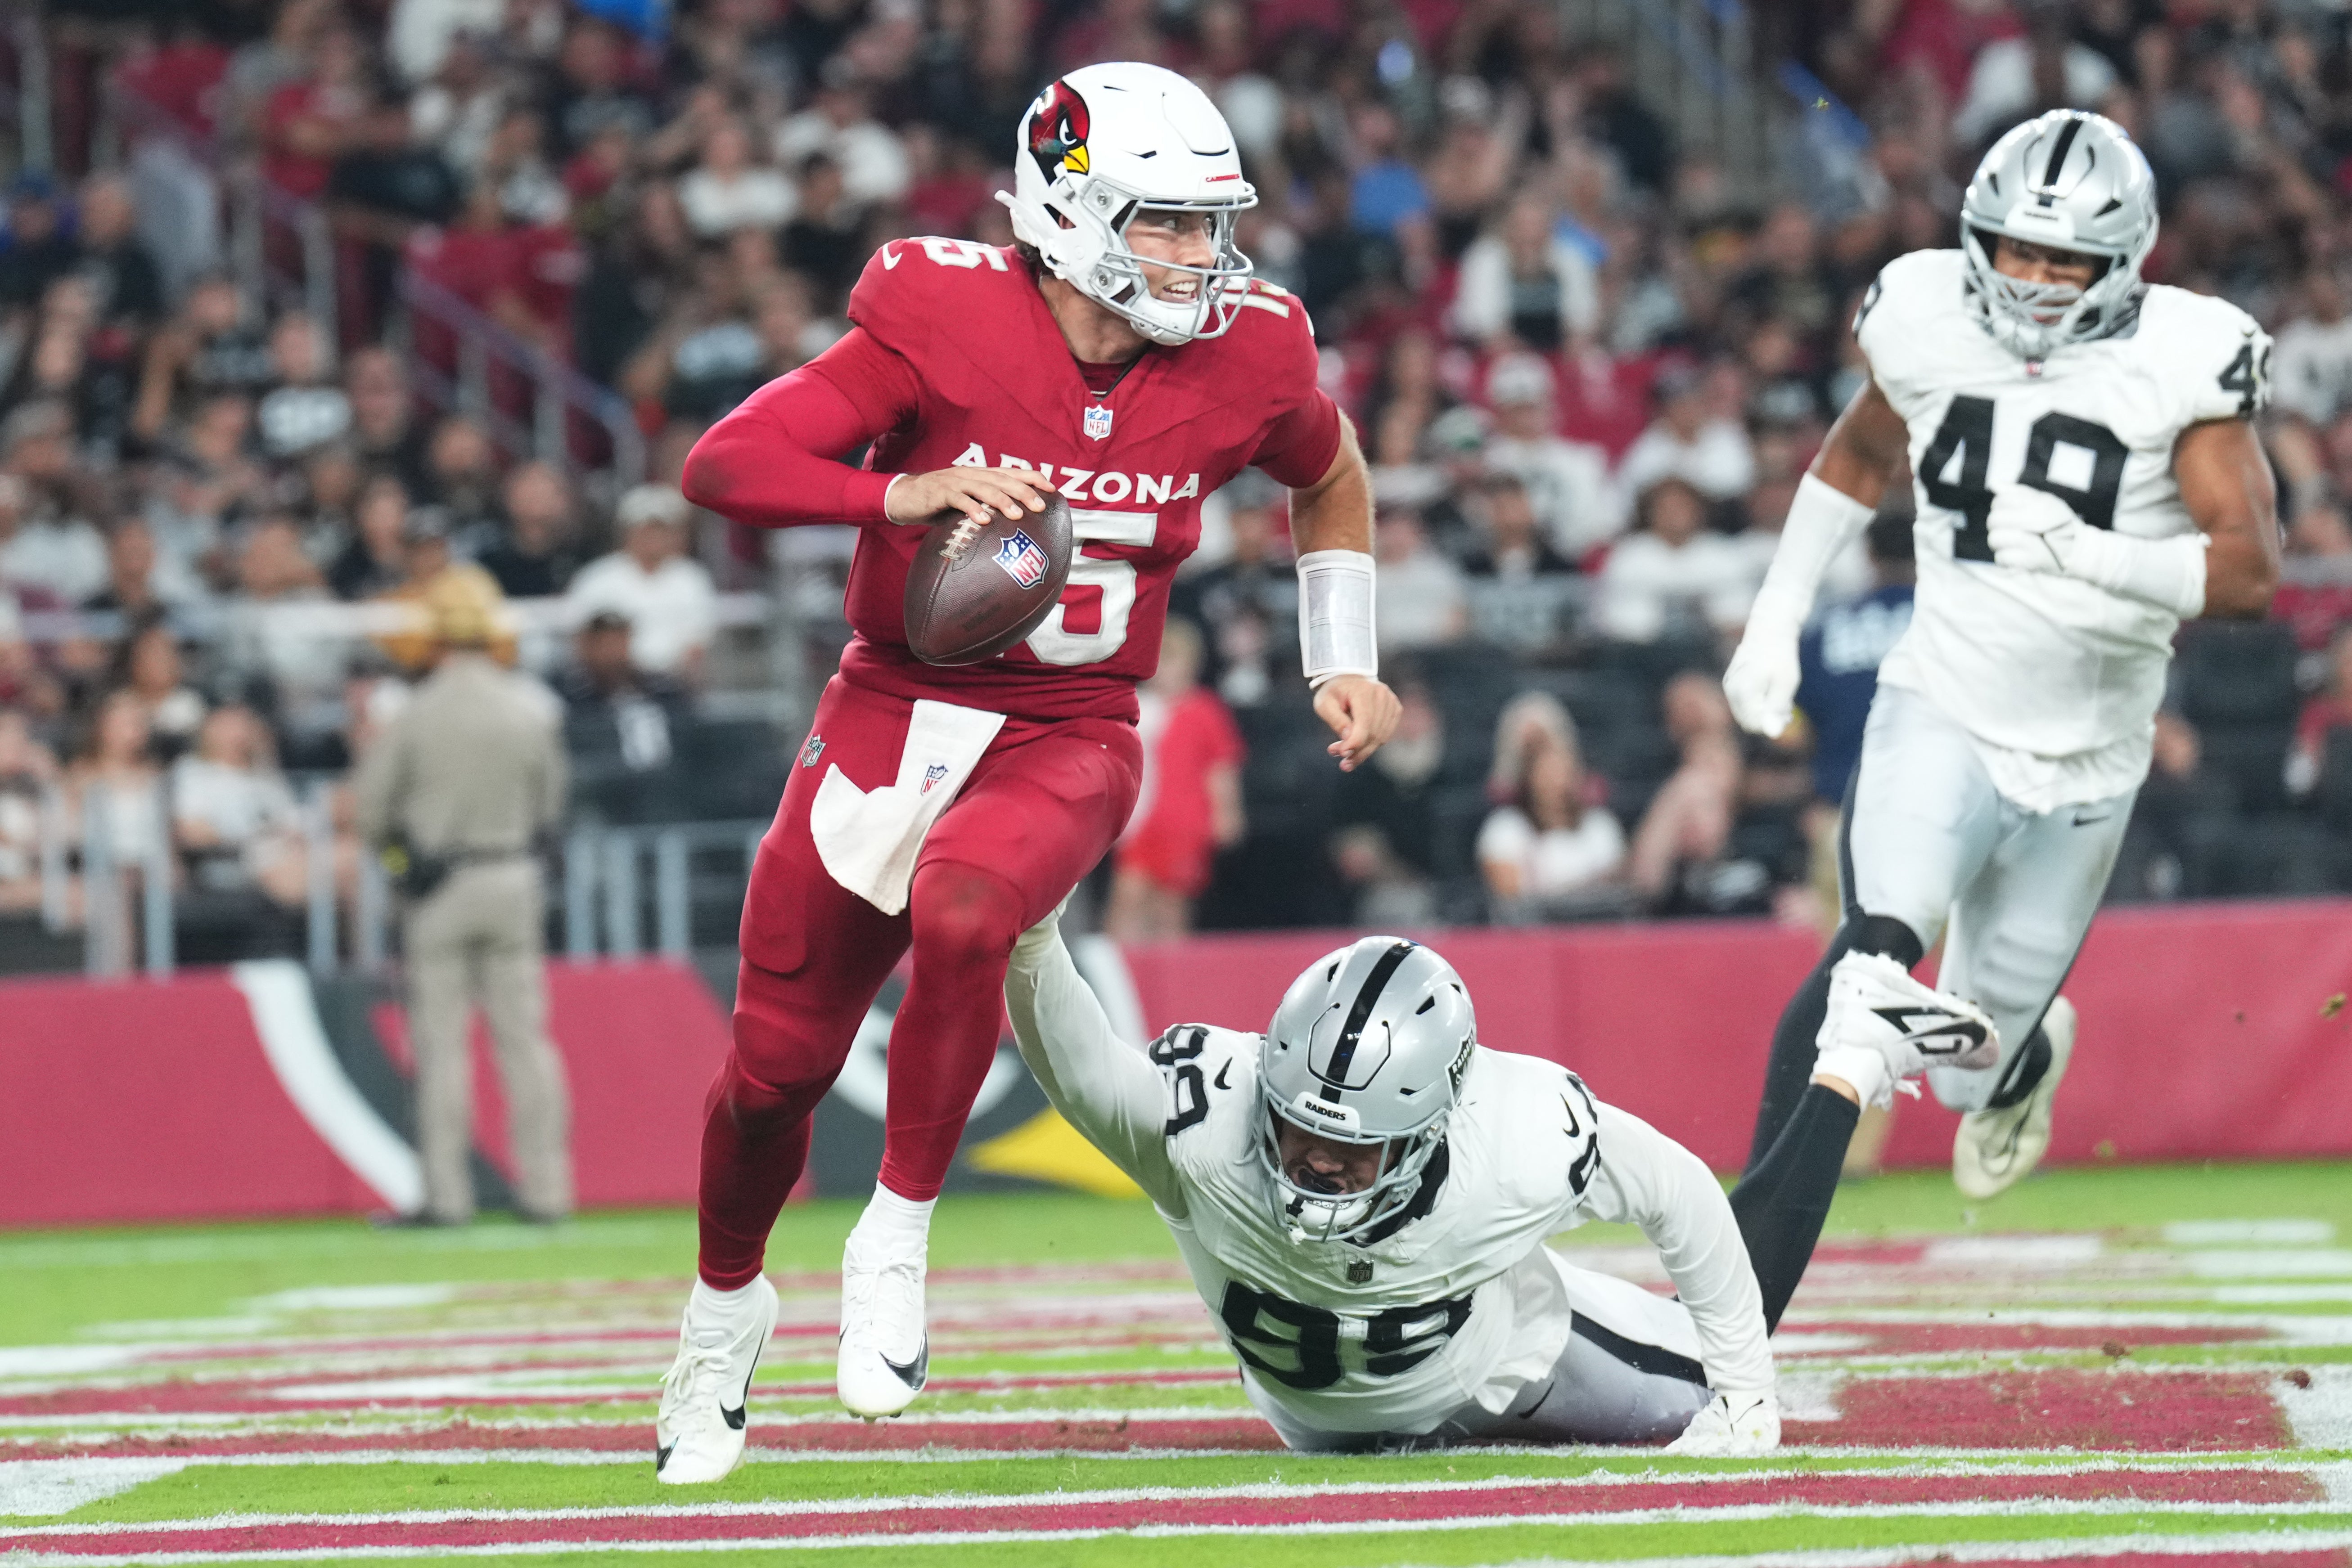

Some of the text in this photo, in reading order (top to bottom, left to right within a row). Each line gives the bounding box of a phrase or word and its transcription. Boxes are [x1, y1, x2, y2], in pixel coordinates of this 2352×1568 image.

[2217, 343, 2271, 417] 4
[1089, 420, 1106, 433] NFL
[1918, 393, 2131, 563] 49
[996, 508, 1158, 667] 5
[1012, 548, 1045, 584] NFL
[1305, 1100, 1346, 1120] RAIDERS
